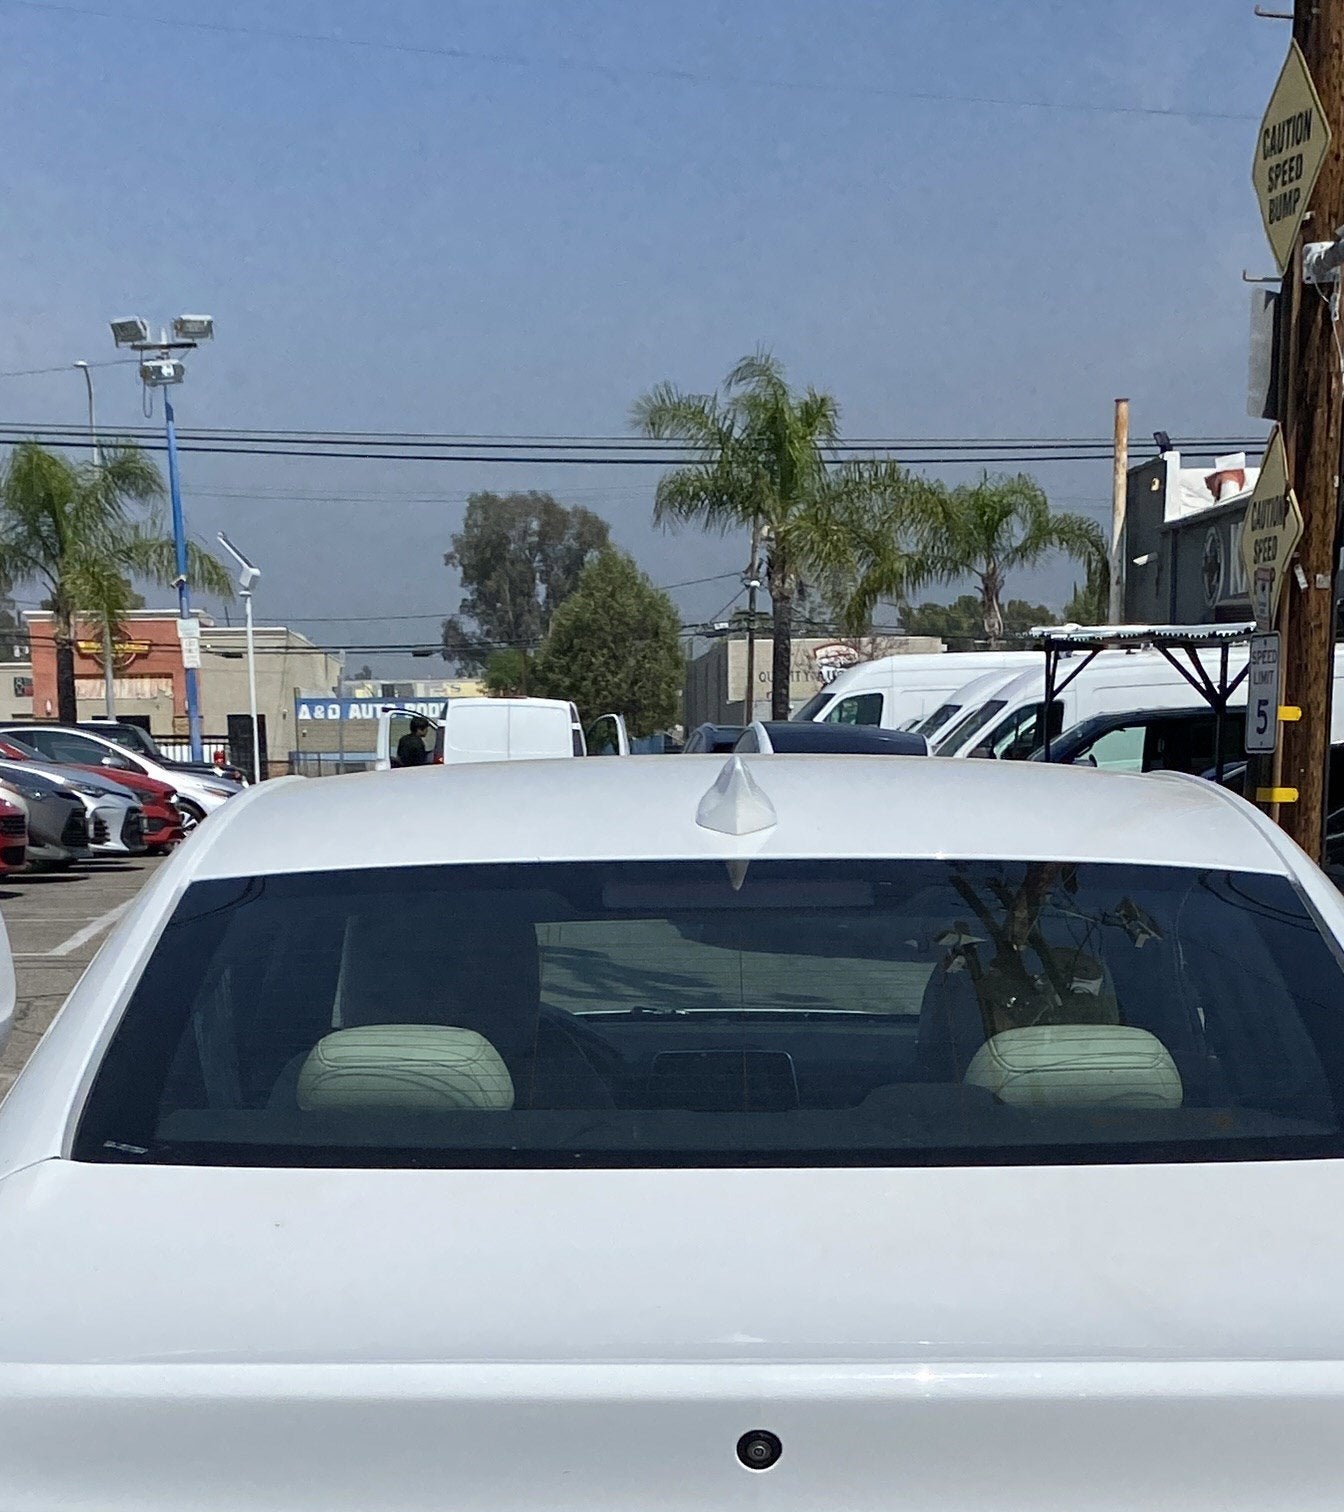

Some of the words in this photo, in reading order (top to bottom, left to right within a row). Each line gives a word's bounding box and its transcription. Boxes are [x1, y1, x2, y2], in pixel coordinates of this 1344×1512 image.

[1263, 108, 1312, 160] CAUTION
[1268, 153, 1303, 193] SPEED
[1268, 188, 1301, 225] BUMP
[1252, 494, 1285, 531] CAUTION
[1254, 535, 1278, 564] SPEED
[1252, 649, 1277, 665] SPEED
[759, 671, 813, 683] QUITY
[1254, 670, 1274, 685] LIMIT
[1256, 699, 1269, 735] 5
